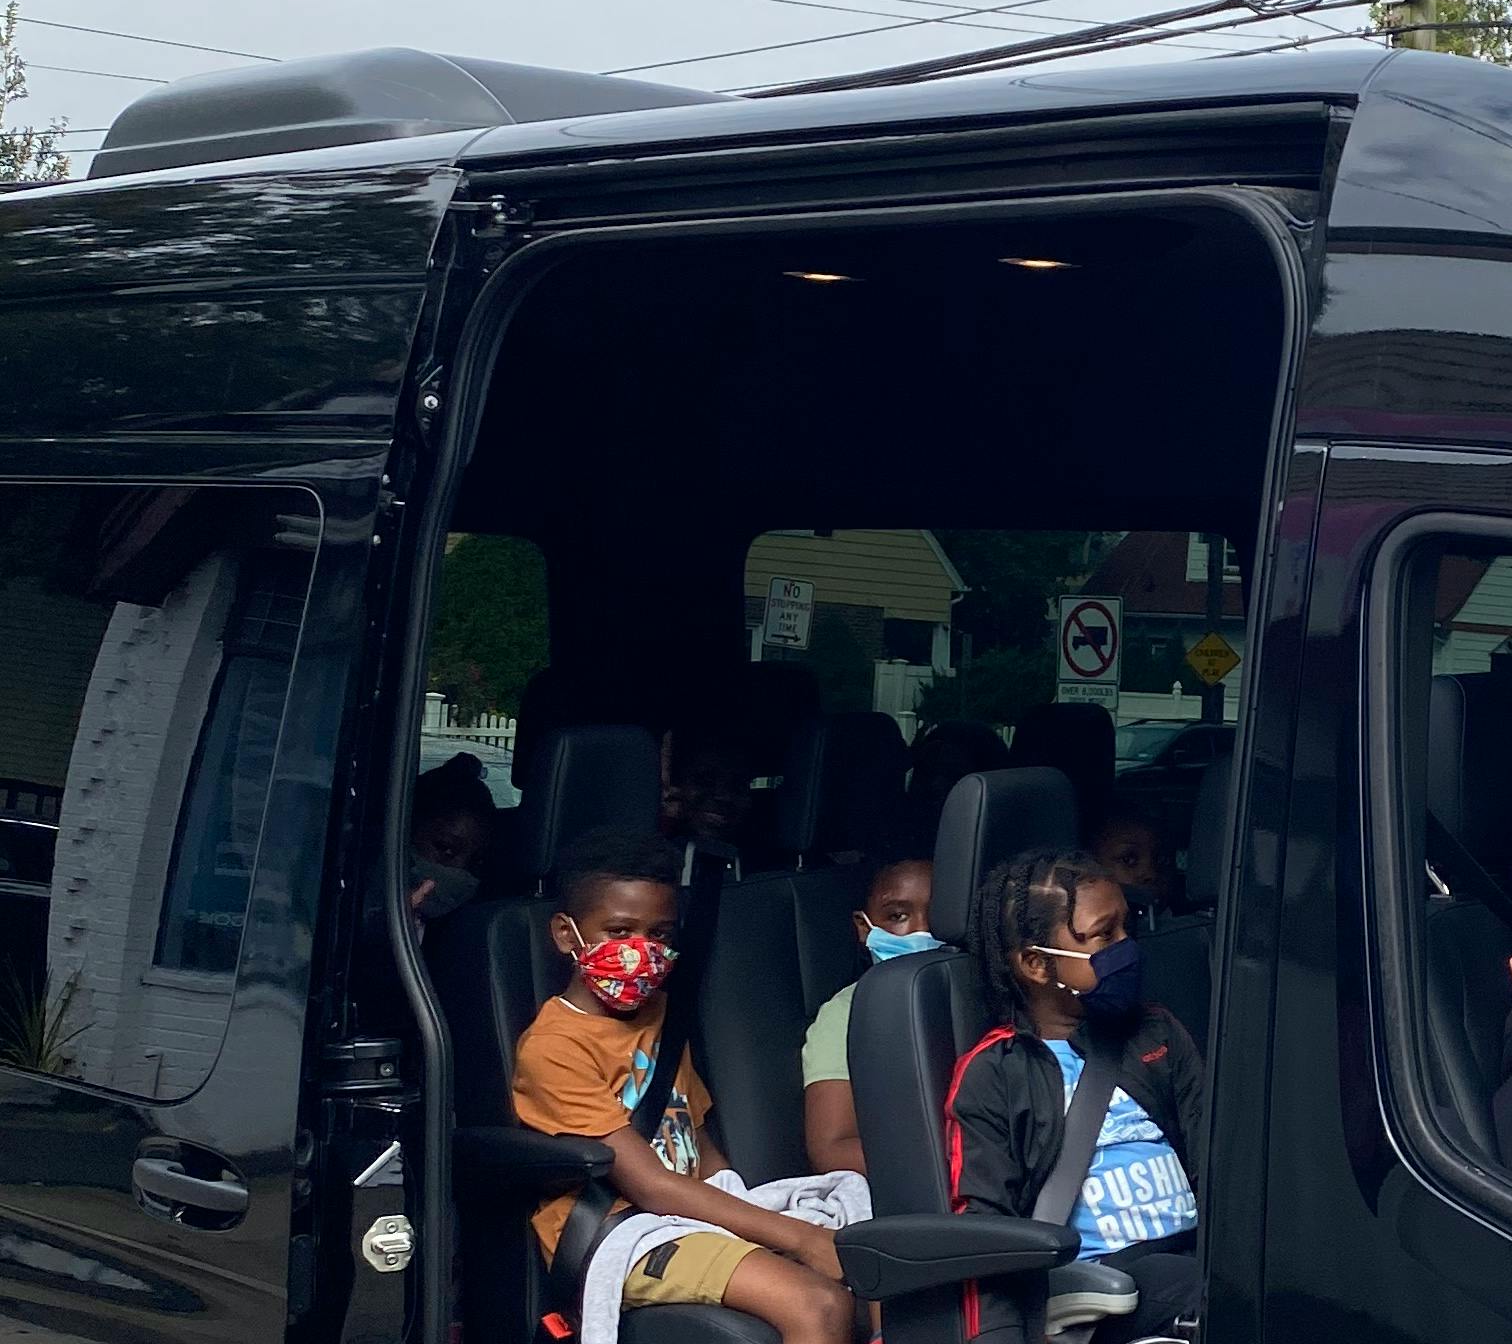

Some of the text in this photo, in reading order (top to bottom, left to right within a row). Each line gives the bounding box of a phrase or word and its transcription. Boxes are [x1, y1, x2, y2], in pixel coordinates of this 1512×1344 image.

[783, 582, 801, 598] NO
[770, 599, 812, 611] STOPPING
[779, 612, 800, 622] ANY
[778, 622, 798, 632] TIME
